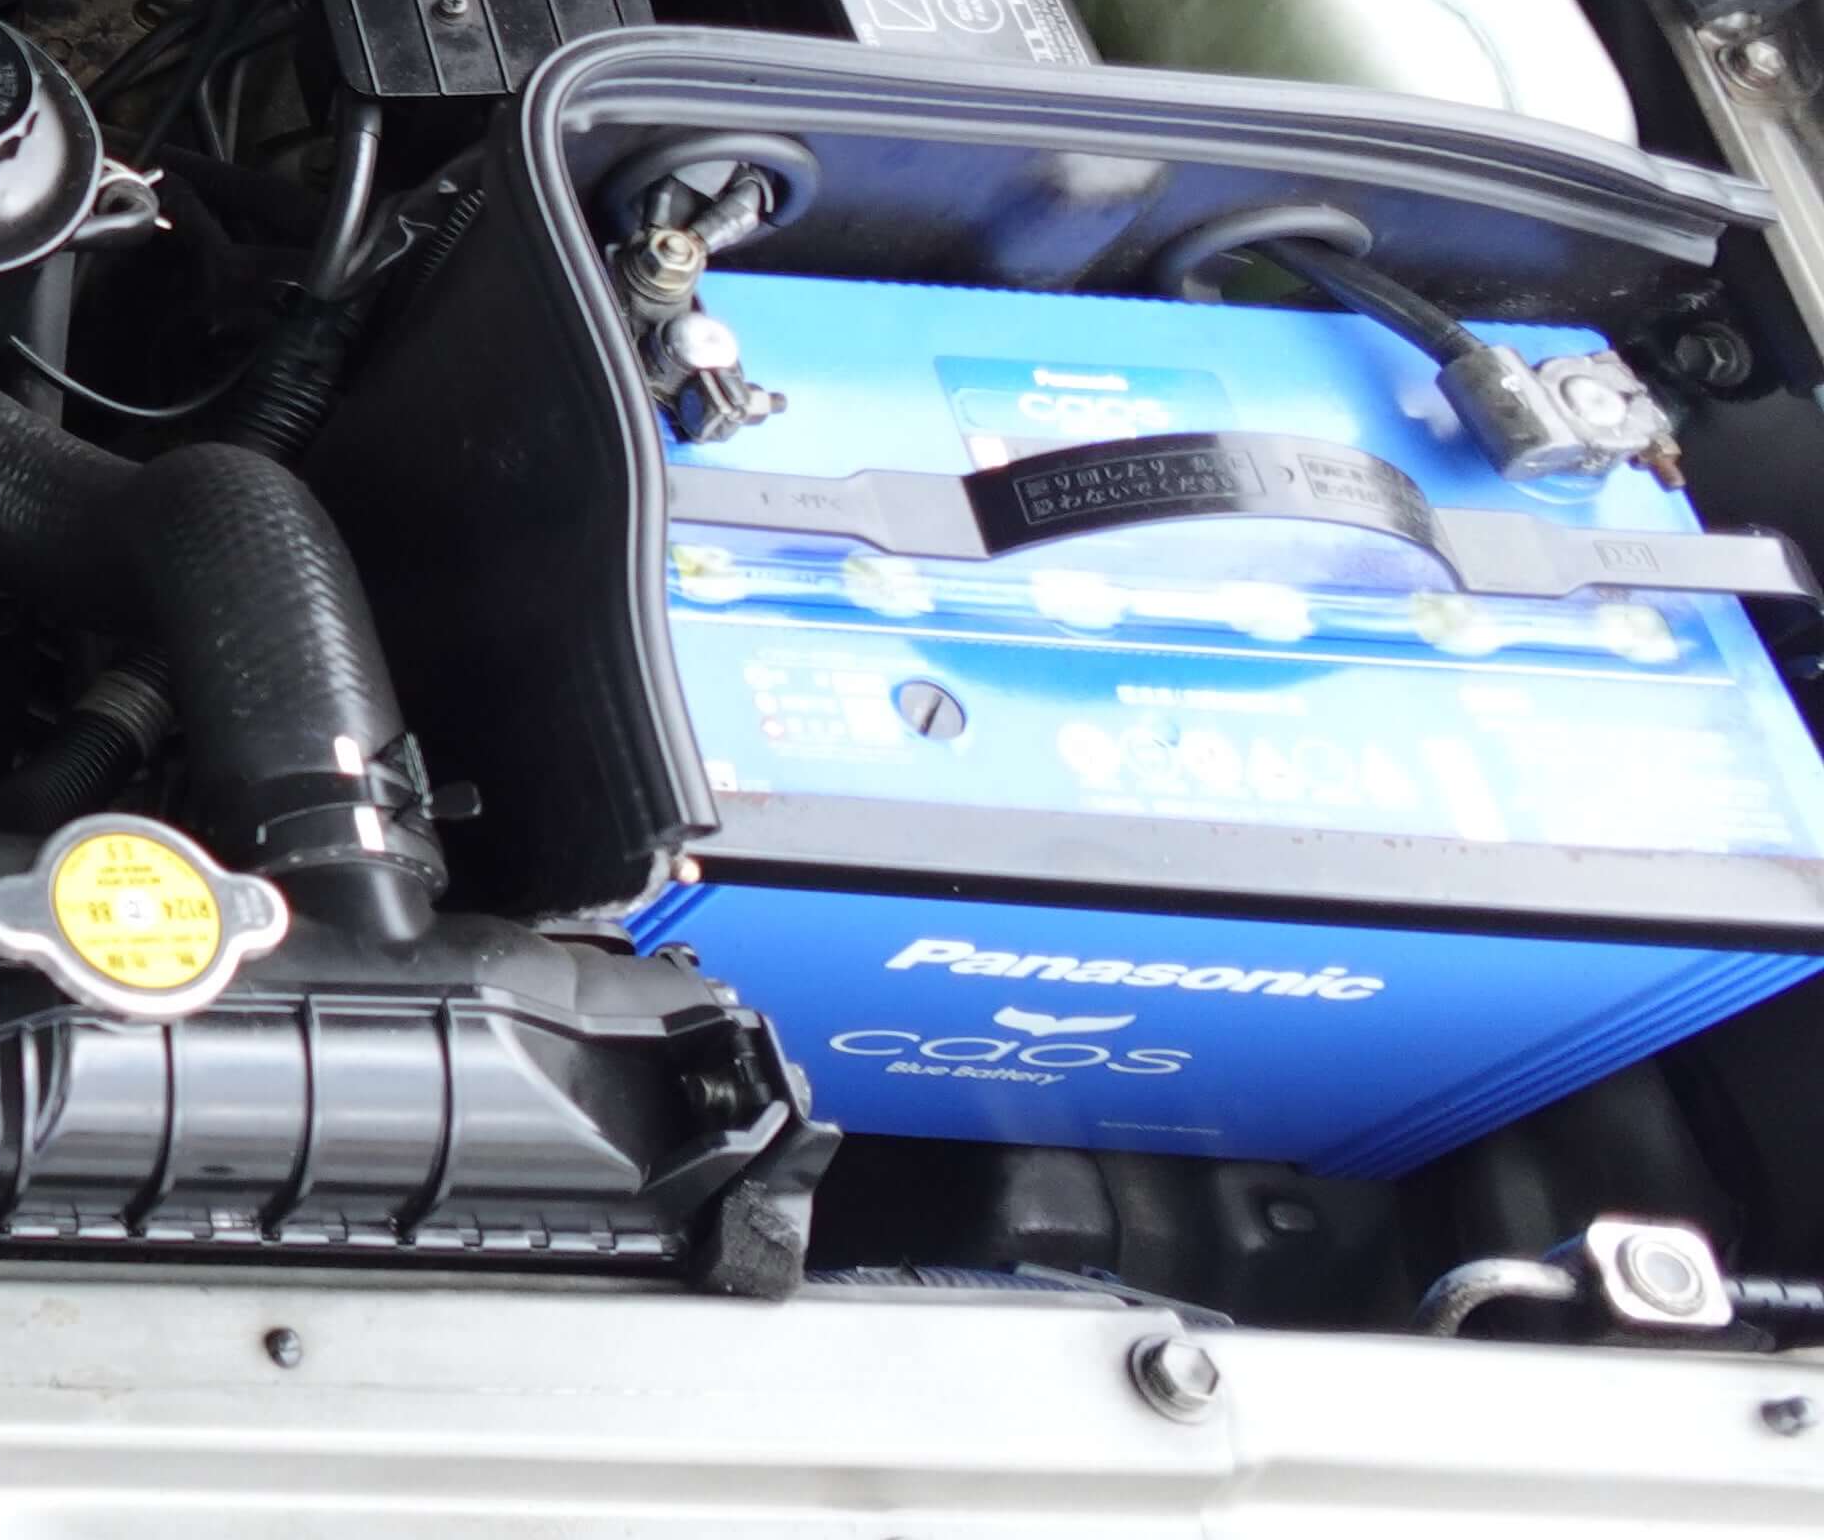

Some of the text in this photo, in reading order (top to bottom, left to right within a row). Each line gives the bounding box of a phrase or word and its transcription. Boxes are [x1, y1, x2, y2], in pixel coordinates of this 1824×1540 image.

[884, 937, 1387, 1002] Panasonic
[828, 1028, 1193, 1075] caos
[886, 1060, 1066, 1086] Blue Battery
